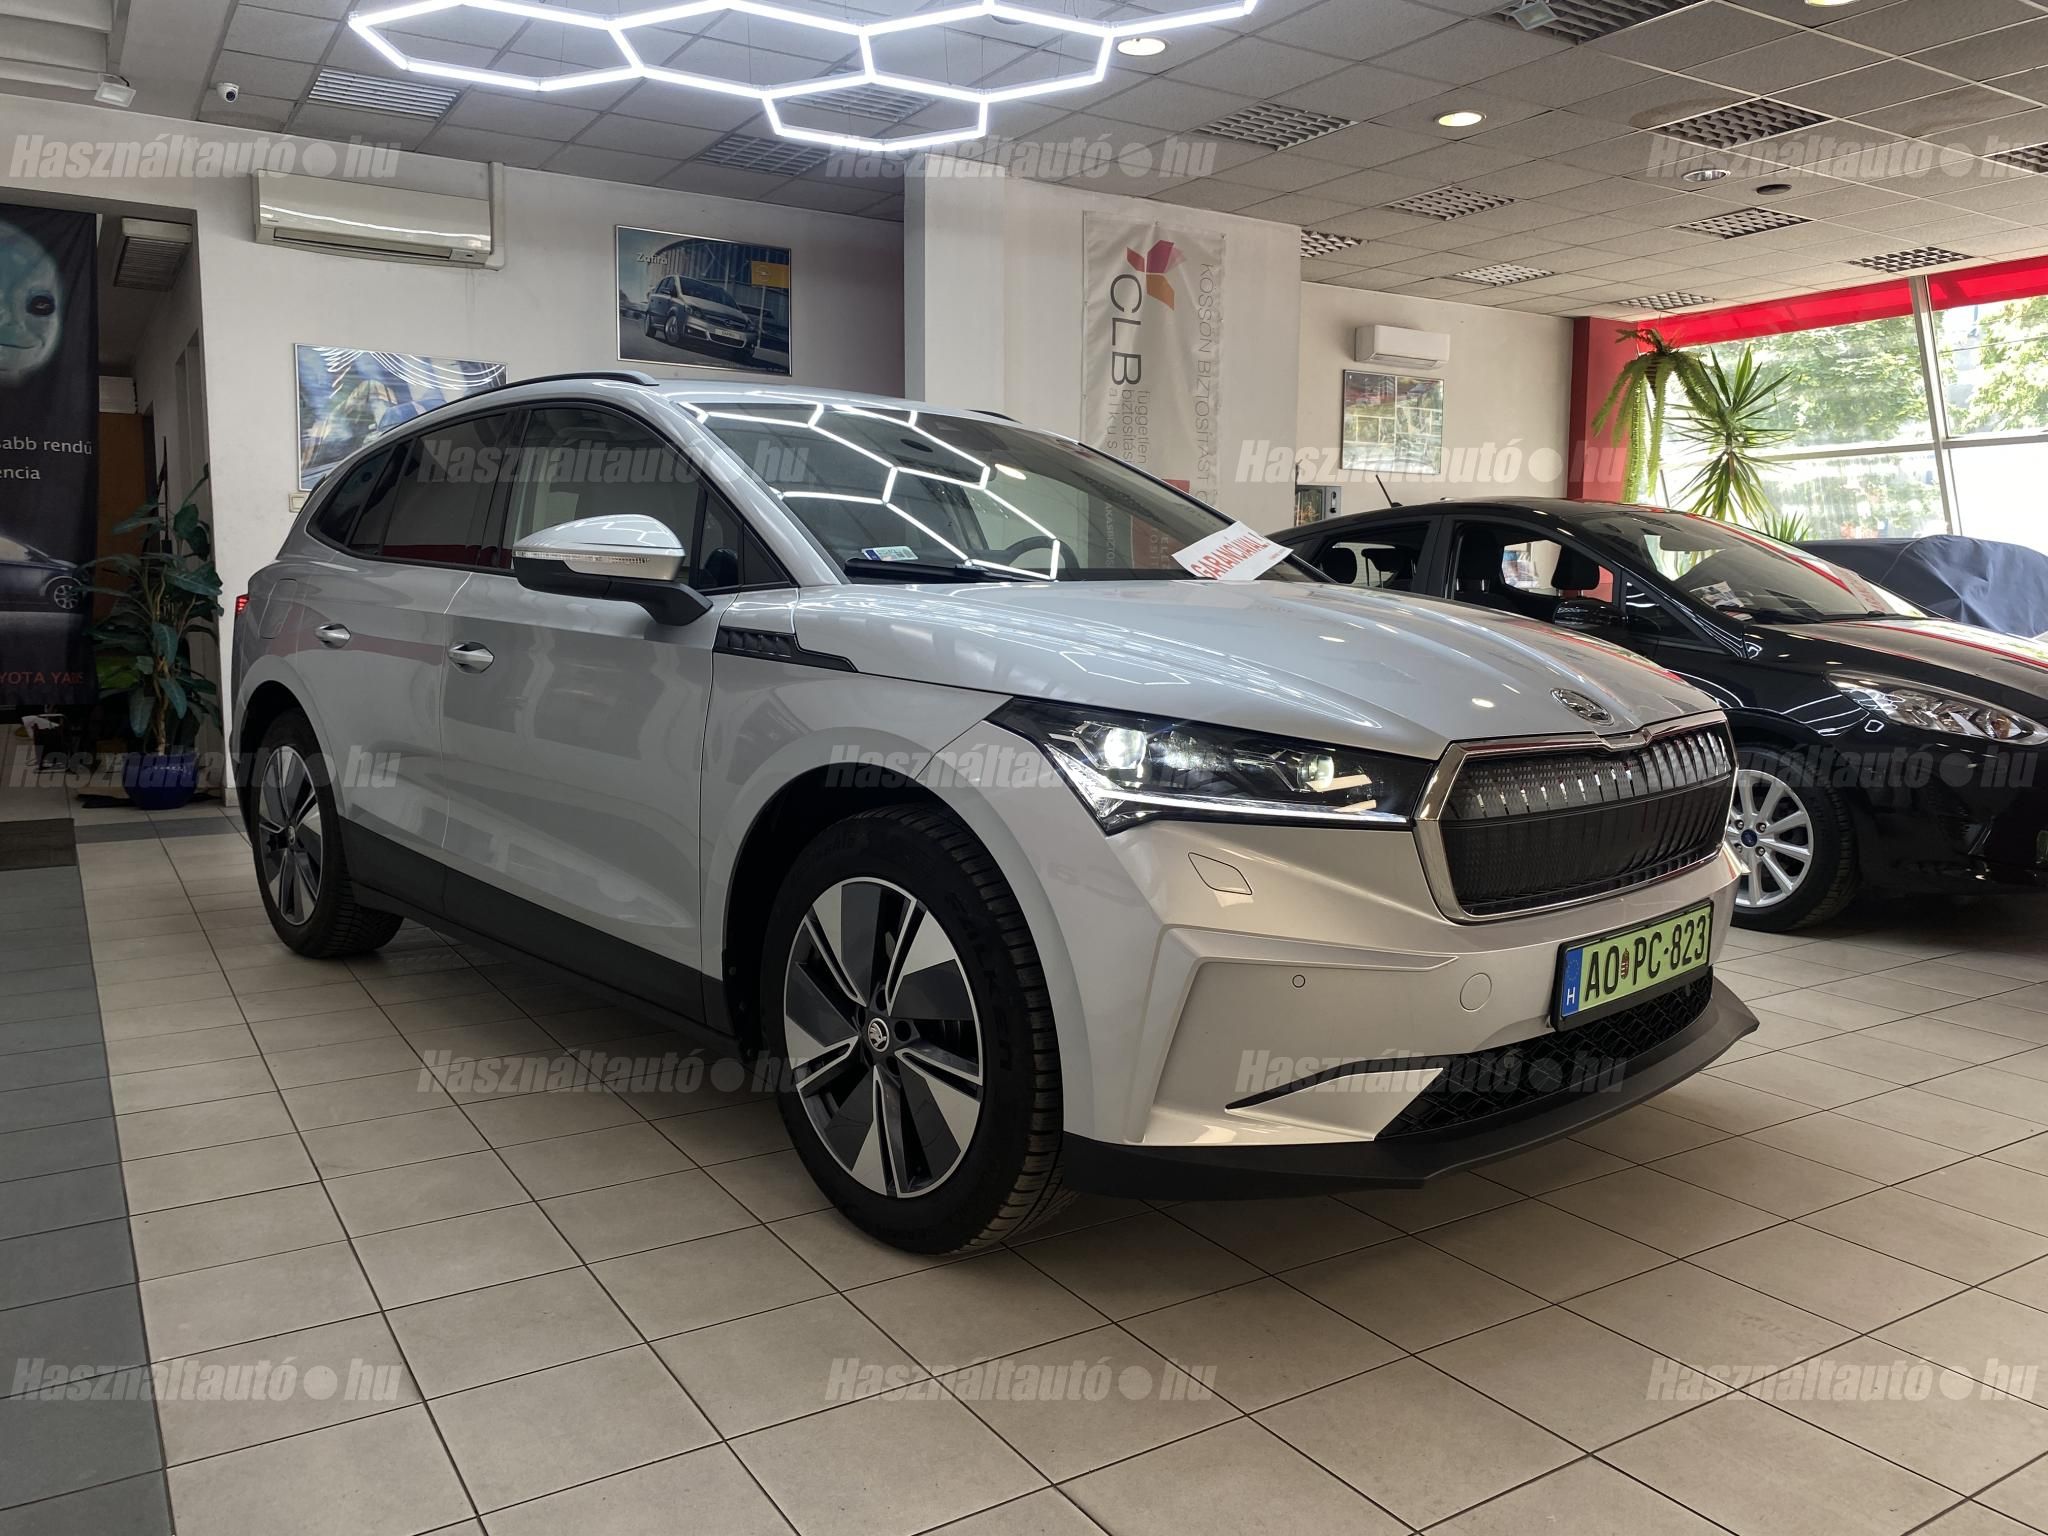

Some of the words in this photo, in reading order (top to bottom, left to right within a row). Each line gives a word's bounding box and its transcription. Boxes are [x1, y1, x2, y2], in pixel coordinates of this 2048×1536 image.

[1110, 274, 1142, 386] CLB
[0, 436, 37, 450] abb
[1566, 986, 1576, 1006] H
